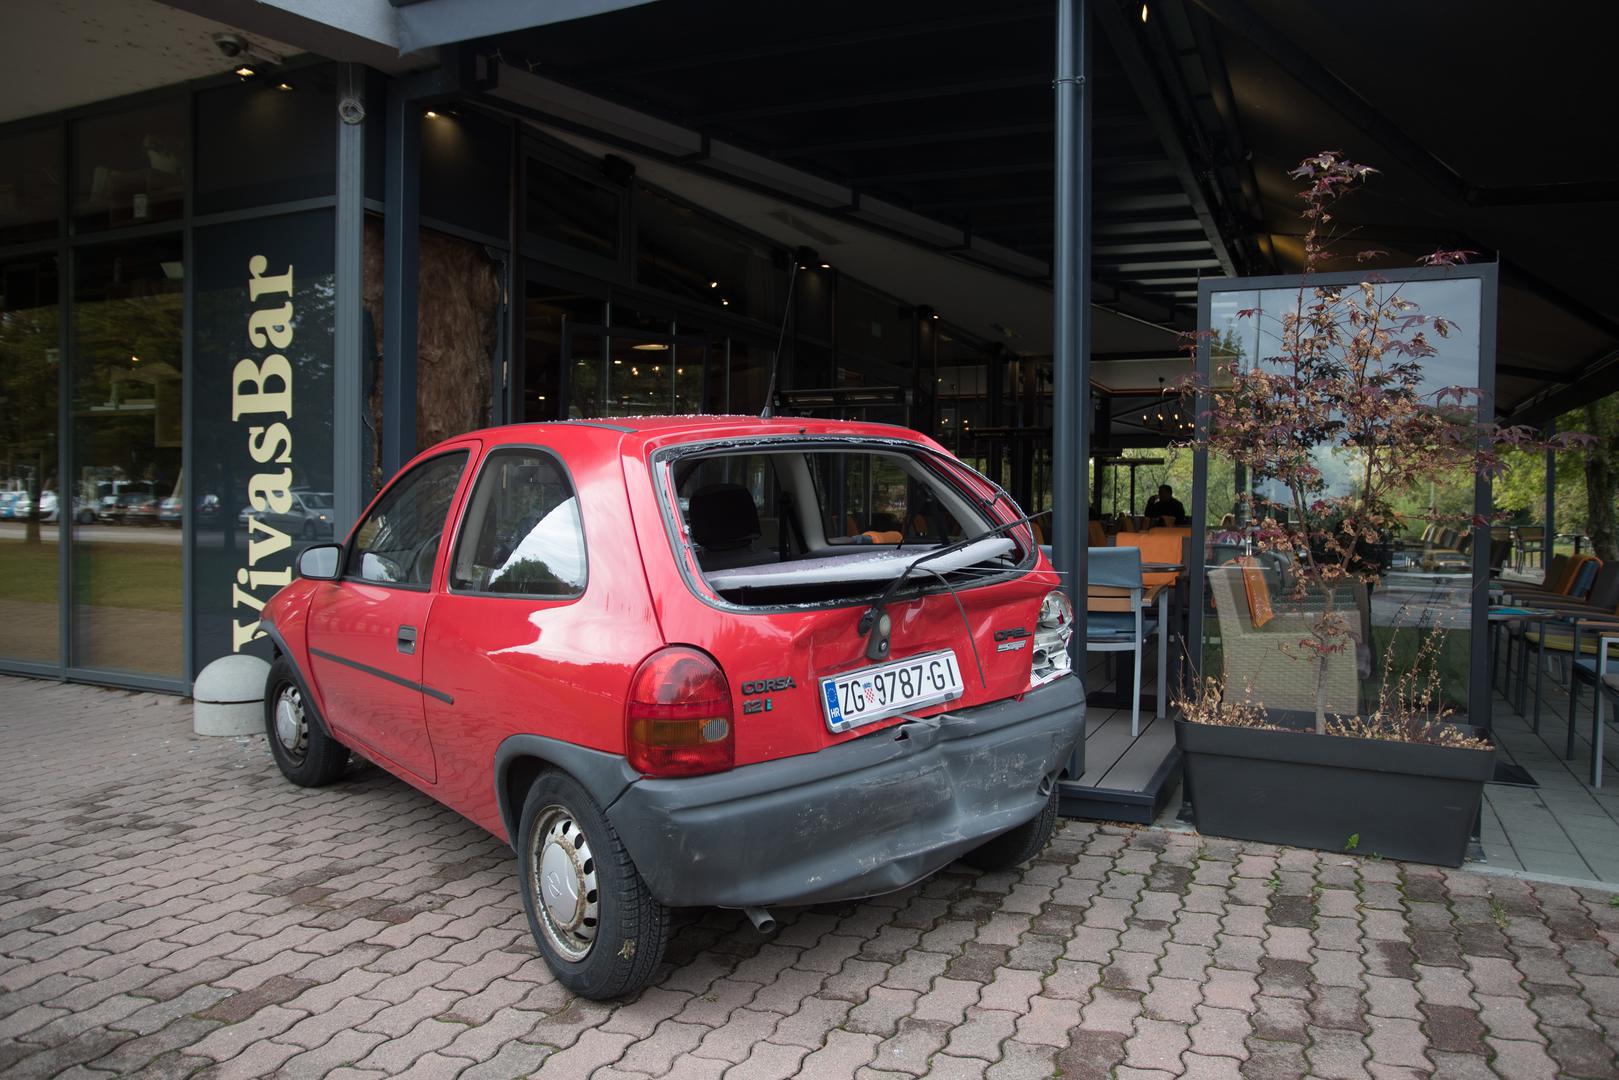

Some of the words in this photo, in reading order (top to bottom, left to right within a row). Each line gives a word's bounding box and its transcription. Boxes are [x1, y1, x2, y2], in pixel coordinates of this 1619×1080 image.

[742, 676, 797, 696] CORSA
[839, 680, 865, 716] ZG
[830, 707, 841, 719] HR
